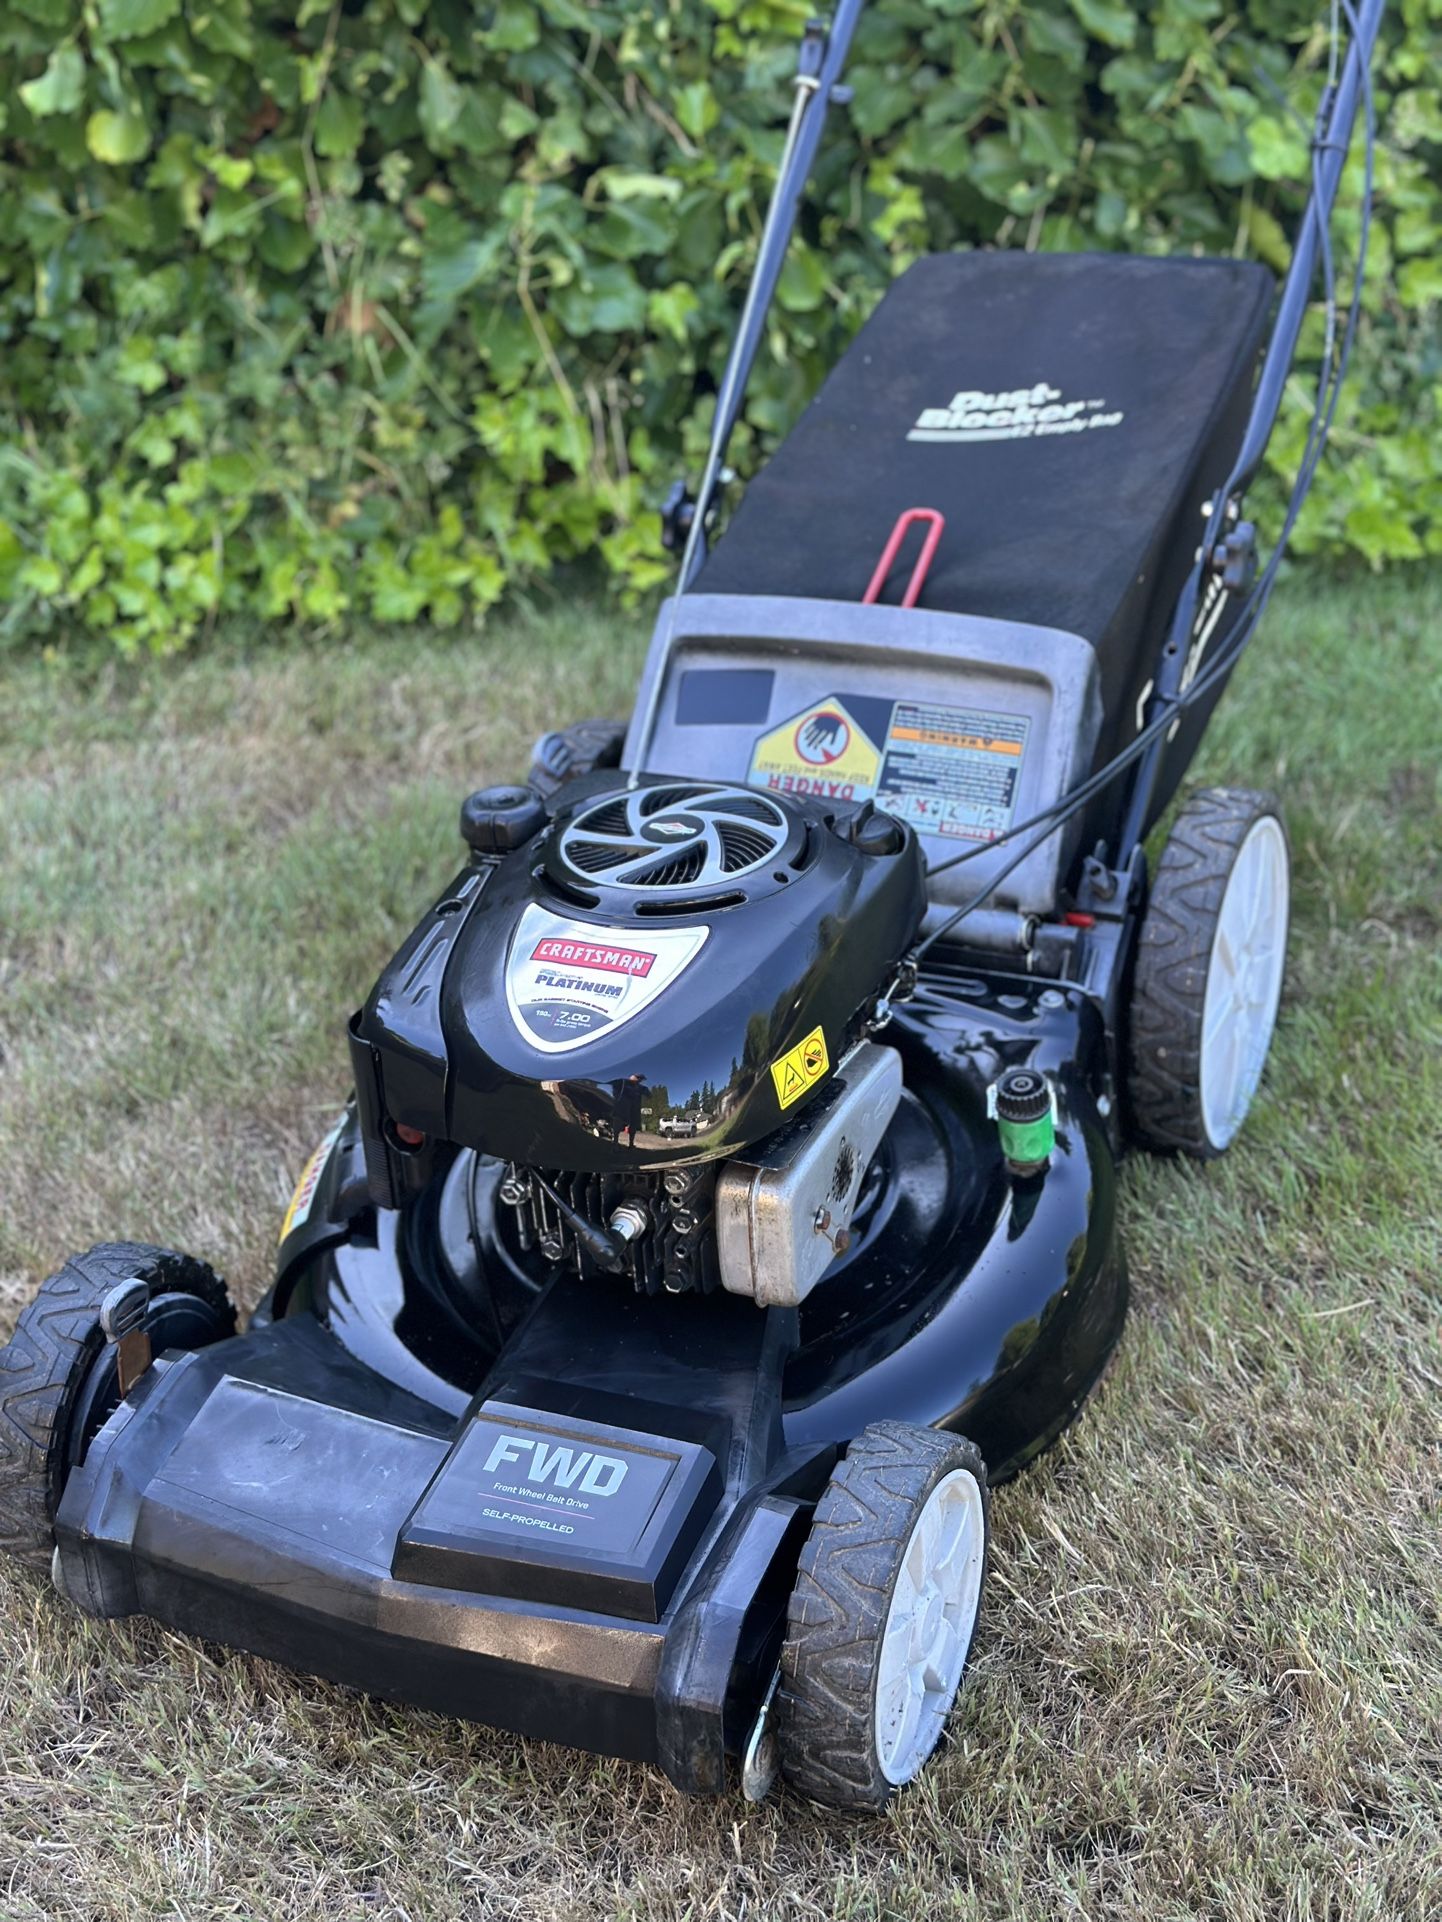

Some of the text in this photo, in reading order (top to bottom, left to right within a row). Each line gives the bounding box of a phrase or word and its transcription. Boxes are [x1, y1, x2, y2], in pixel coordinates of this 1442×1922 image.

[767, 773, 855, 801] DANGER
[540, 943, 646, 970] CRAFTSMAN
[535, 974, 624, 997] PLATINUM
[558, 1010, 591, 1023] 7.00
[482, 1434, 629, 1496] FWD
[493, 1482, 589, 1510] Front Wheel Belt Drive
[482, 1508, 574, 1534] SELF-PROPELLED
